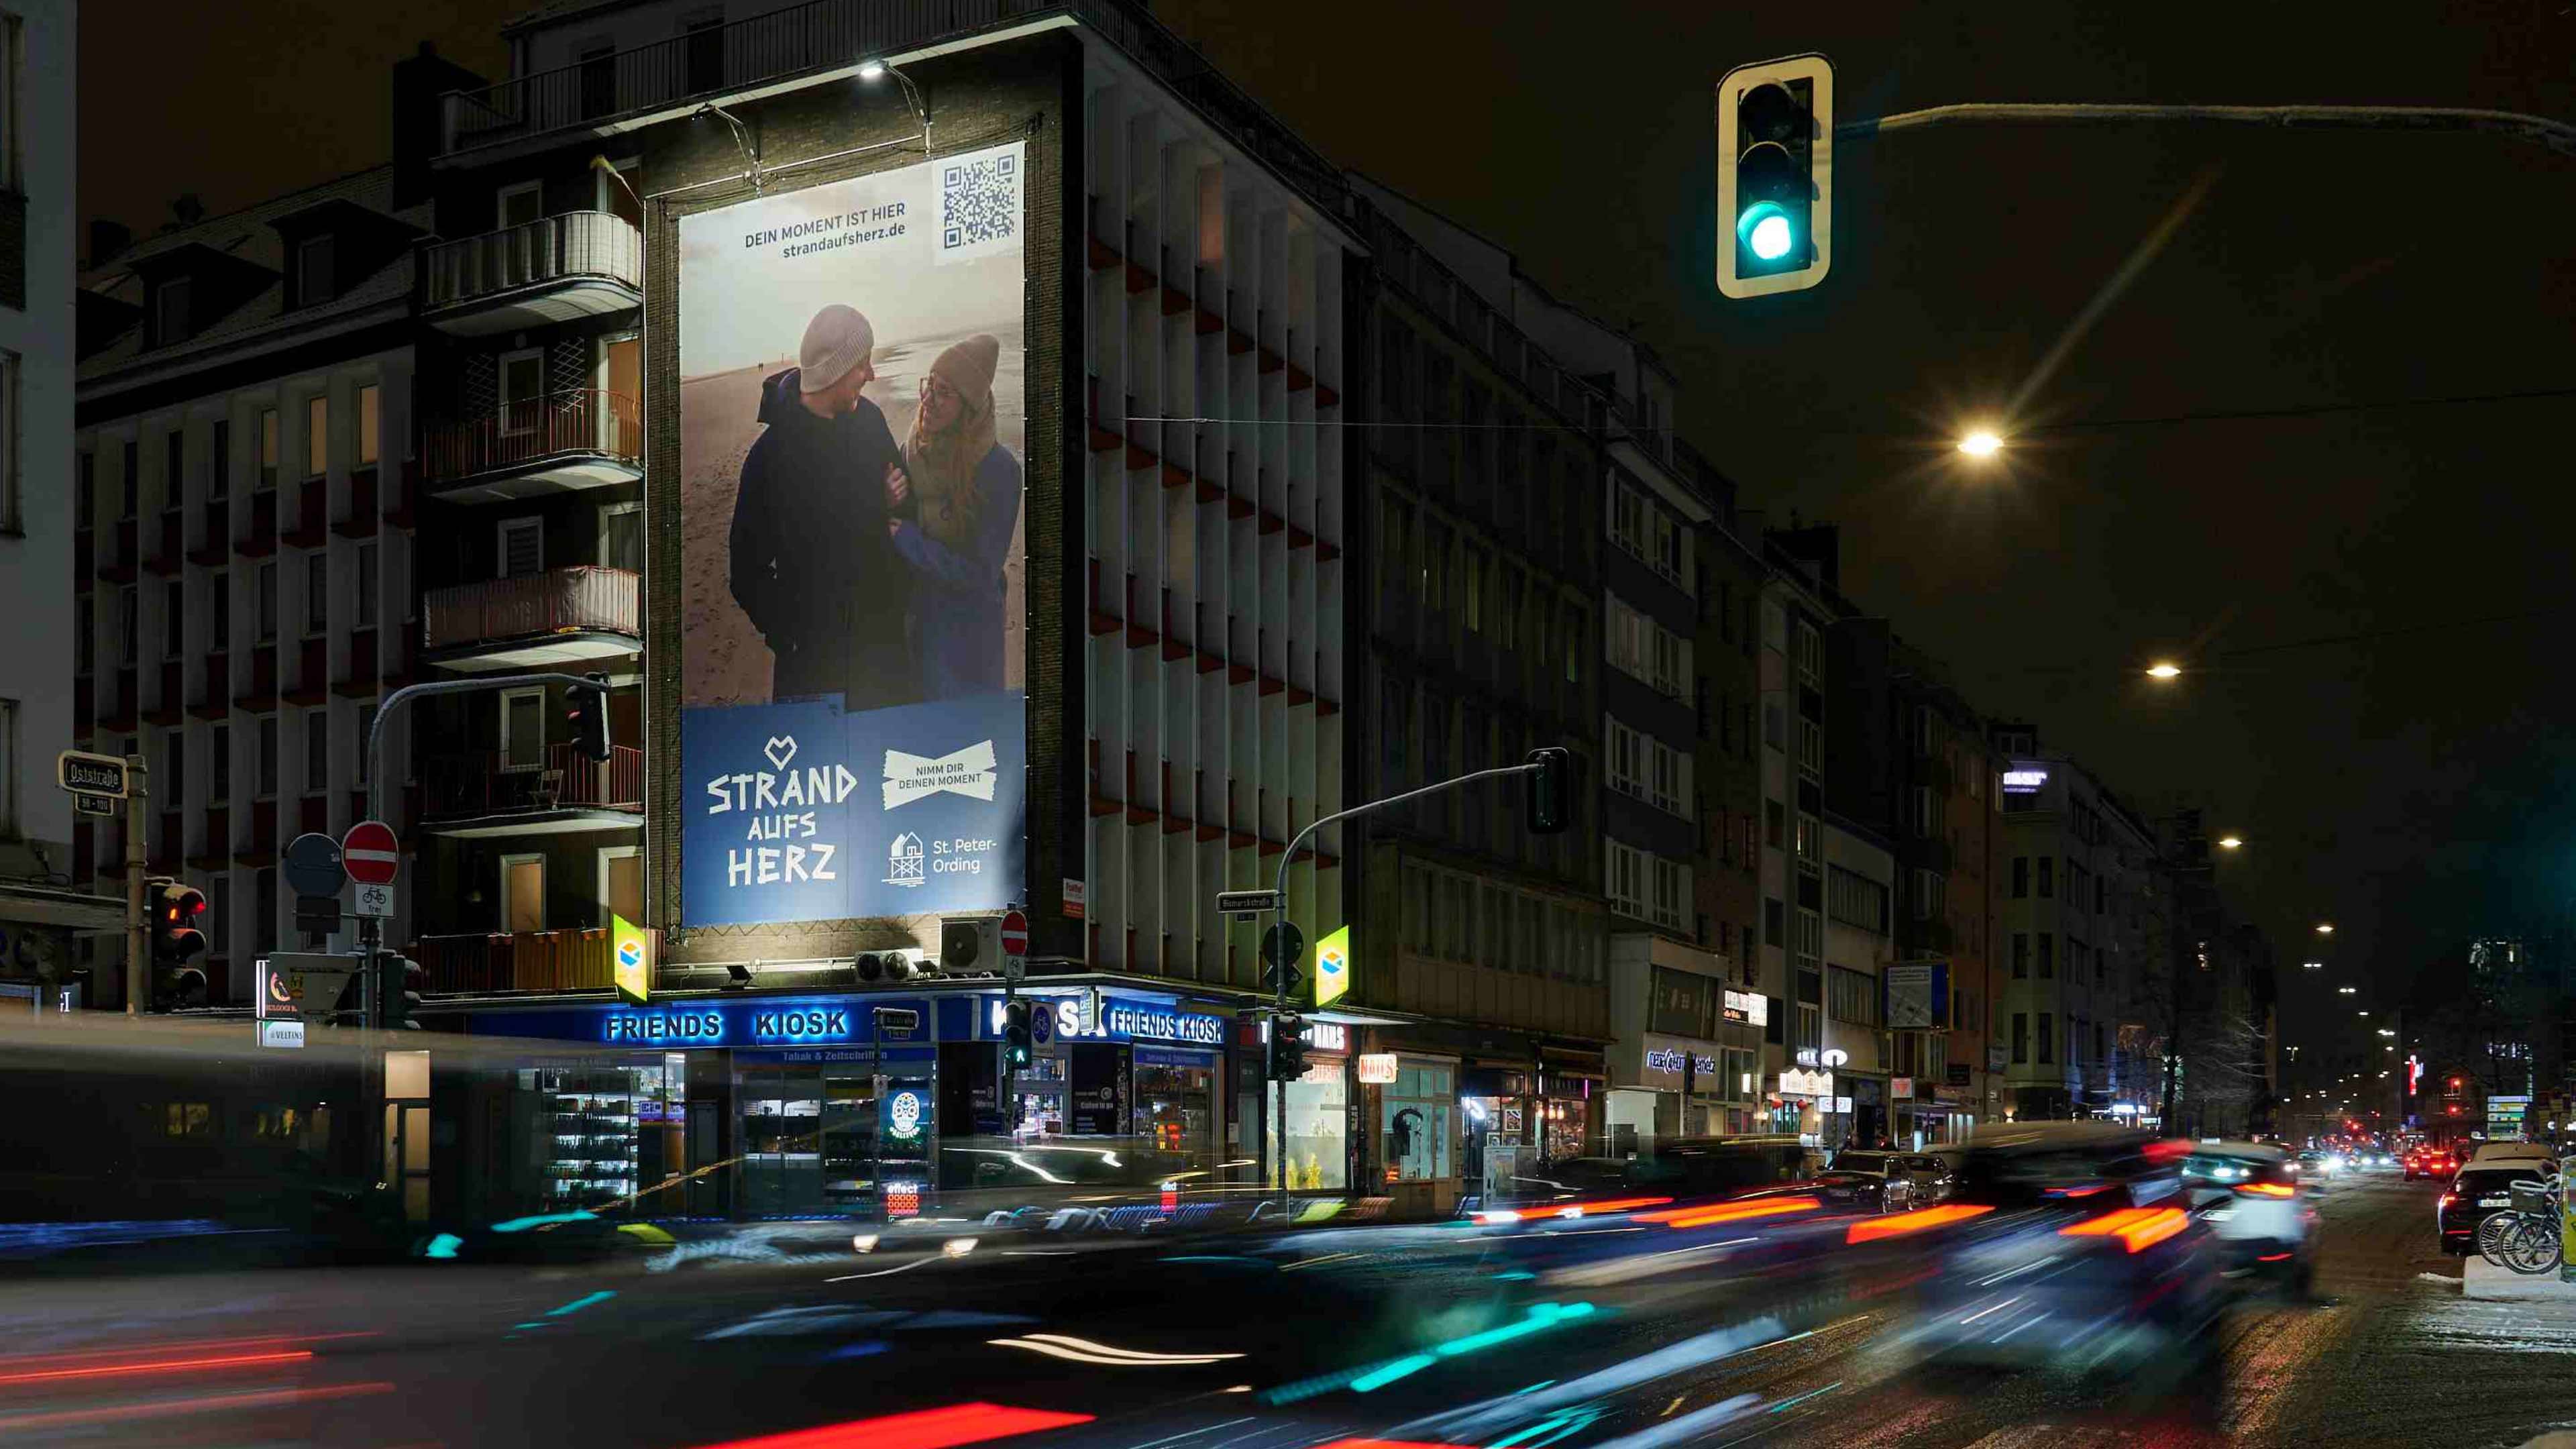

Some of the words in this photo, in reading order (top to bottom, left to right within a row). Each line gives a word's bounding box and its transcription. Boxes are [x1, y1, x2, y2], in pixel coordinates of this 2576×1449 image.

[745, 229, 777, 248] DEIN
[782, 215, 843, 240] MOMENT
[847, 210, 867, 227] IST
[872, 203, 905, 221] HIER
[783, 222, 906, 258] strandaufsherz.de
[899, 777, 935, 790] DEINEN
[938, 773, 981, 786] MOMENT
[916, 765, 943, 776] NIMM
[947, 763, 964, 773] DIR
[708, 764, 858, 814] STRAND
[747, 812, 816, 841] AUFS
[933, 841, 952, 855] St.
[955, 838, 998, 853] Peter-
[729, 843, 837, 887] HERZ
[933, 857, 980, 873] Ording
[606, 1014, 720, 1039] FRIENDS
[755, 1010, 846, 1036] KIOSK
[1114, 1010, 1175, 1036] FRIENDS
[1183, 1016, 1224, 1042] KIOSK
